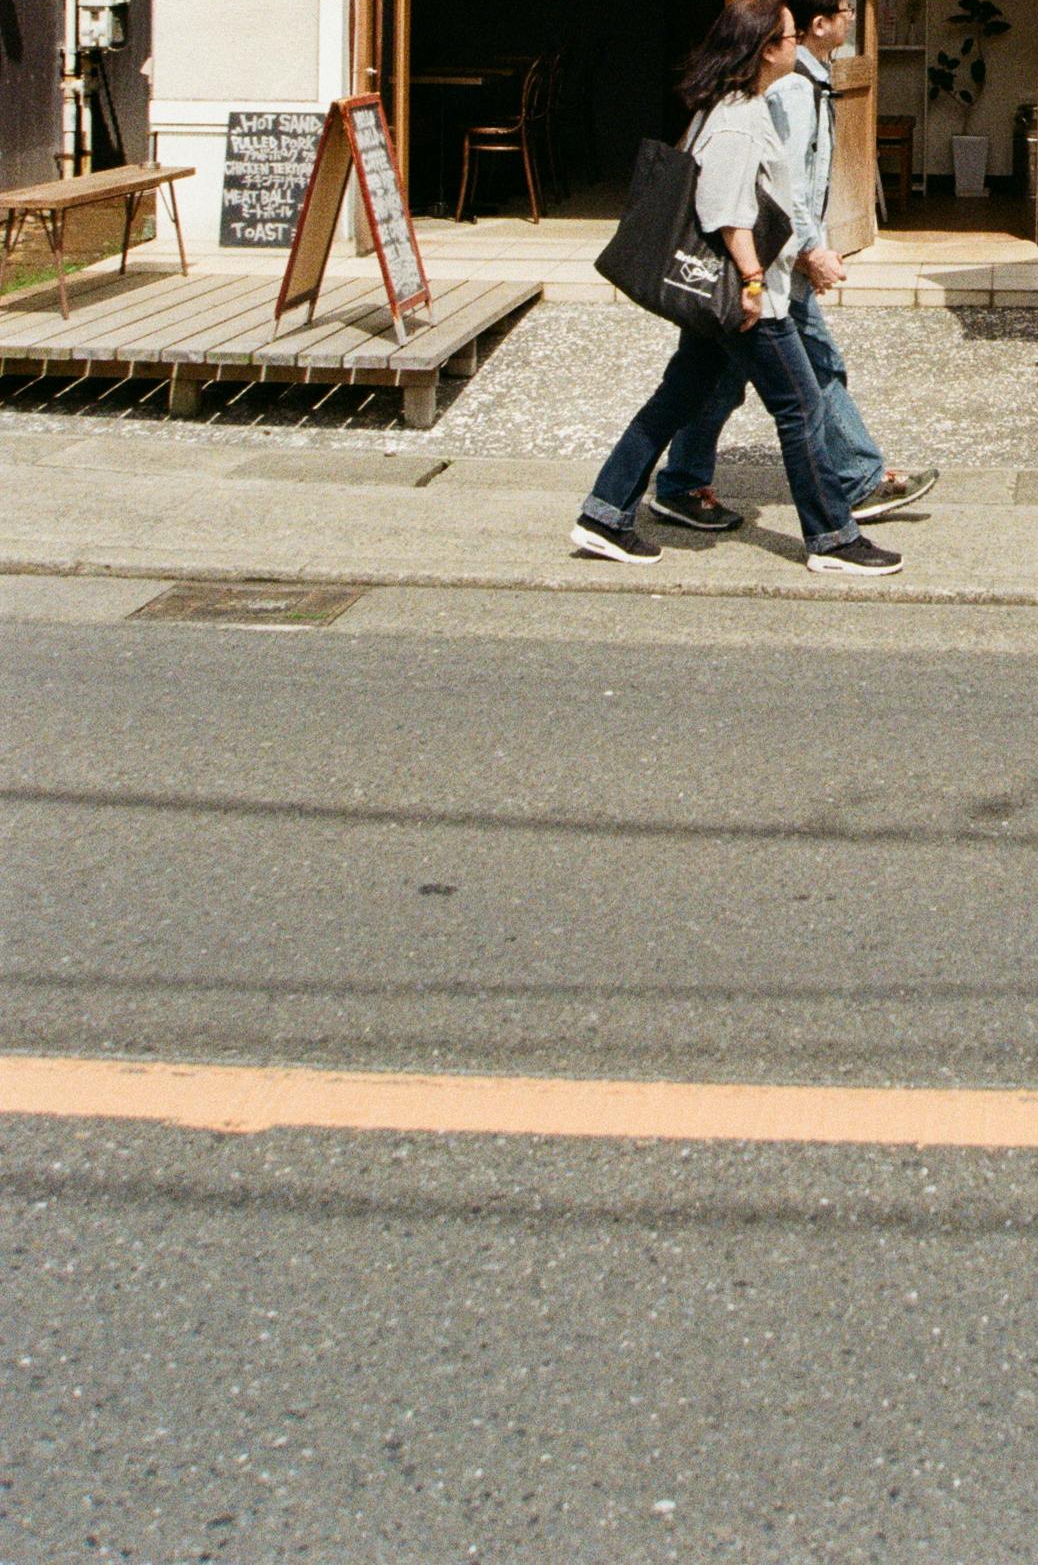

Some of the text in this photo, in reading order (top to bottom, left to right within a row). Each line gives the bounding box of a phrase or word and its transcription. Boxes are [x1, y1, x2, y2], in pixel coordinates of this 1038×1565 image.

[230, 135, 278, 154] PULLED
[225, 162, 270, 176] CHICKEN
[224, 188, 295, 207] MEAT BALL
